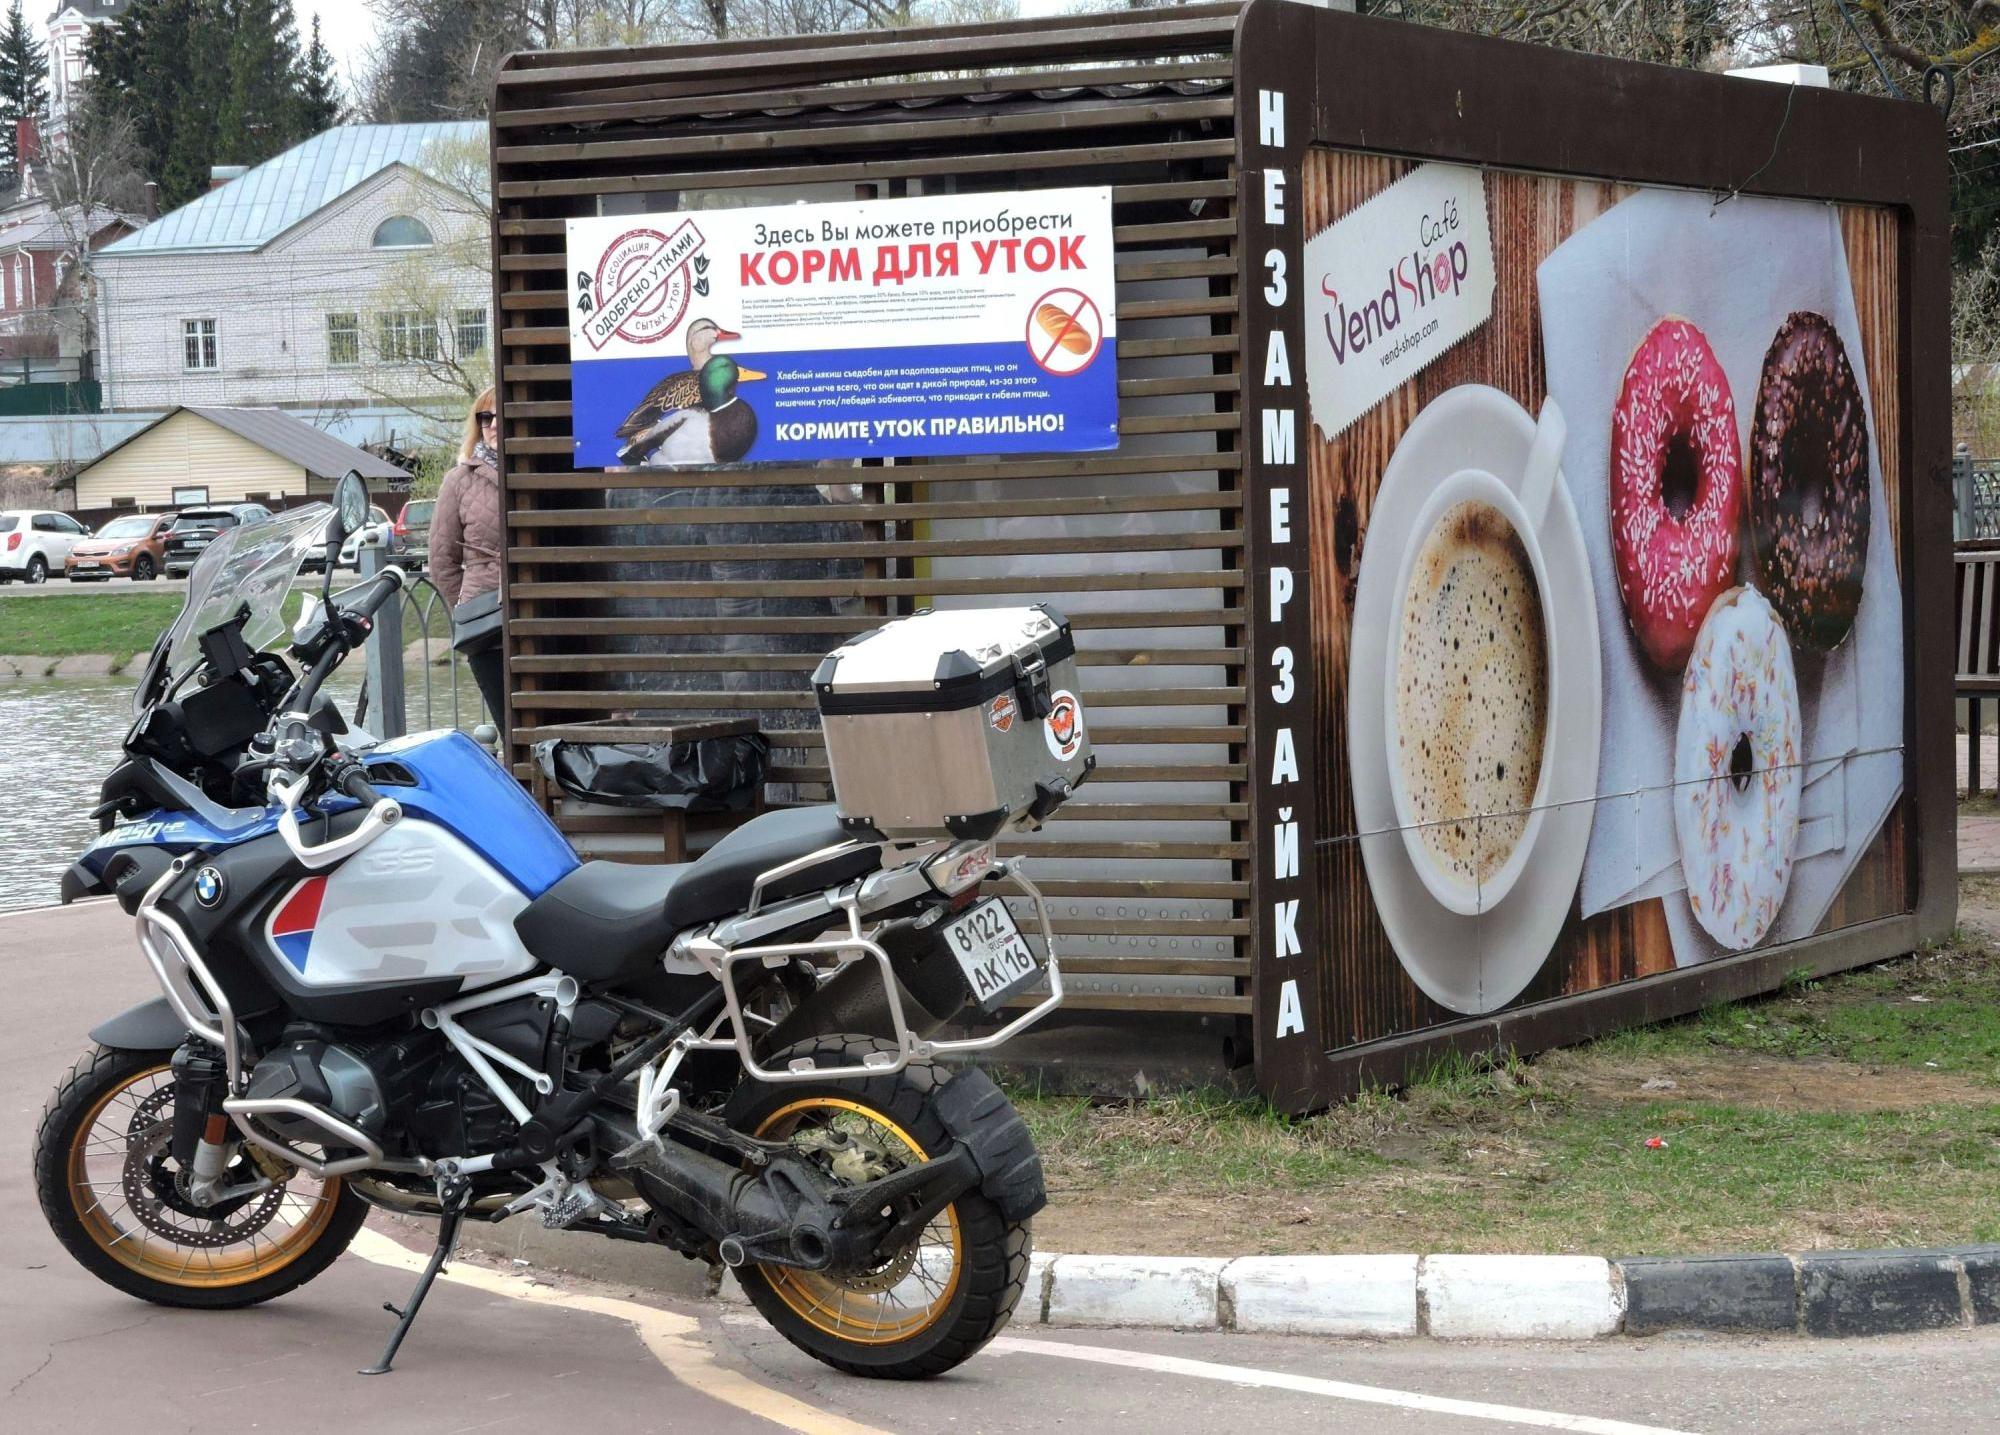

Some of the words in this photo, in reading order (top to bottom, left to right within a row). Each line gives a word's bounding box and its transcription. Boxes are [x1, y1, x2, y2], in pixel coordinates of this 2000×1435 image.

[754, 223, 815, 248] Здесь
[821, 220, 849, 243] Вы
[855, 217, 935, 241] можете
[942, 209, 1073, 240] приобрести
[1420, 197, 1460, 248] Café
[607, 242, 650, 287] АССОЦИАЦИЯ
[740, 247, 863, 287] КОРМ
[873, 242, 959, 287] ДЛЯ
[971, 235, 1088, 274] УТОК
[595, 278, 650, 336] ОДОБРЕНО
[649, 233, 695, 281] УТКАМИ
[635, 313, 668, 331] СЫТЫХ
[667, 282, 681, 311] УТОК
[1380, 318, 1439, 367] vend-shop.com
[775, 384, 810, 394] намного
[812, 383, 835, 393] мягче
[836, 383, 861, 393] всего,
[863, 382, 877, 390] что
[879, 382, 894, 390] они
[896, 382, 914, 391] едят
[922, 379, 948, 389] дикой
[990, 377, 1013, 386] из-за
[1014, 376, 1037, 385] этого
[777, 370, 813, 380] Хлебный
[815, 370, 842, 379] мякиш
[843, 367, 883, 379] съедобен
[884, 368, 899, 377] для
[900, 366, 969, 376] водоплавающих
[775, 398, 816, 408] кишечник
[817, 395, 876, 408] уток/лебедей
[929, 394, 942, 402] что
[944, 392, 983, 403] приводит
[992, 389, 1021, 399] гибели
[776, 420, 870, 441] КОРМИТЕ
[873, 419, 926, 438] УТОК
[931, 413, 1065, 436] ПРАВИЛЬНО!
[1259, 89, 1304, 1039] НЕЗАМЕРЗАЙКА
[955, 907, 1005, 952] 8122
[989, 939, 1005, 951] RUS
[973, 958, 1006, 996] AK
[1005, 944, 1030, 973] 16
